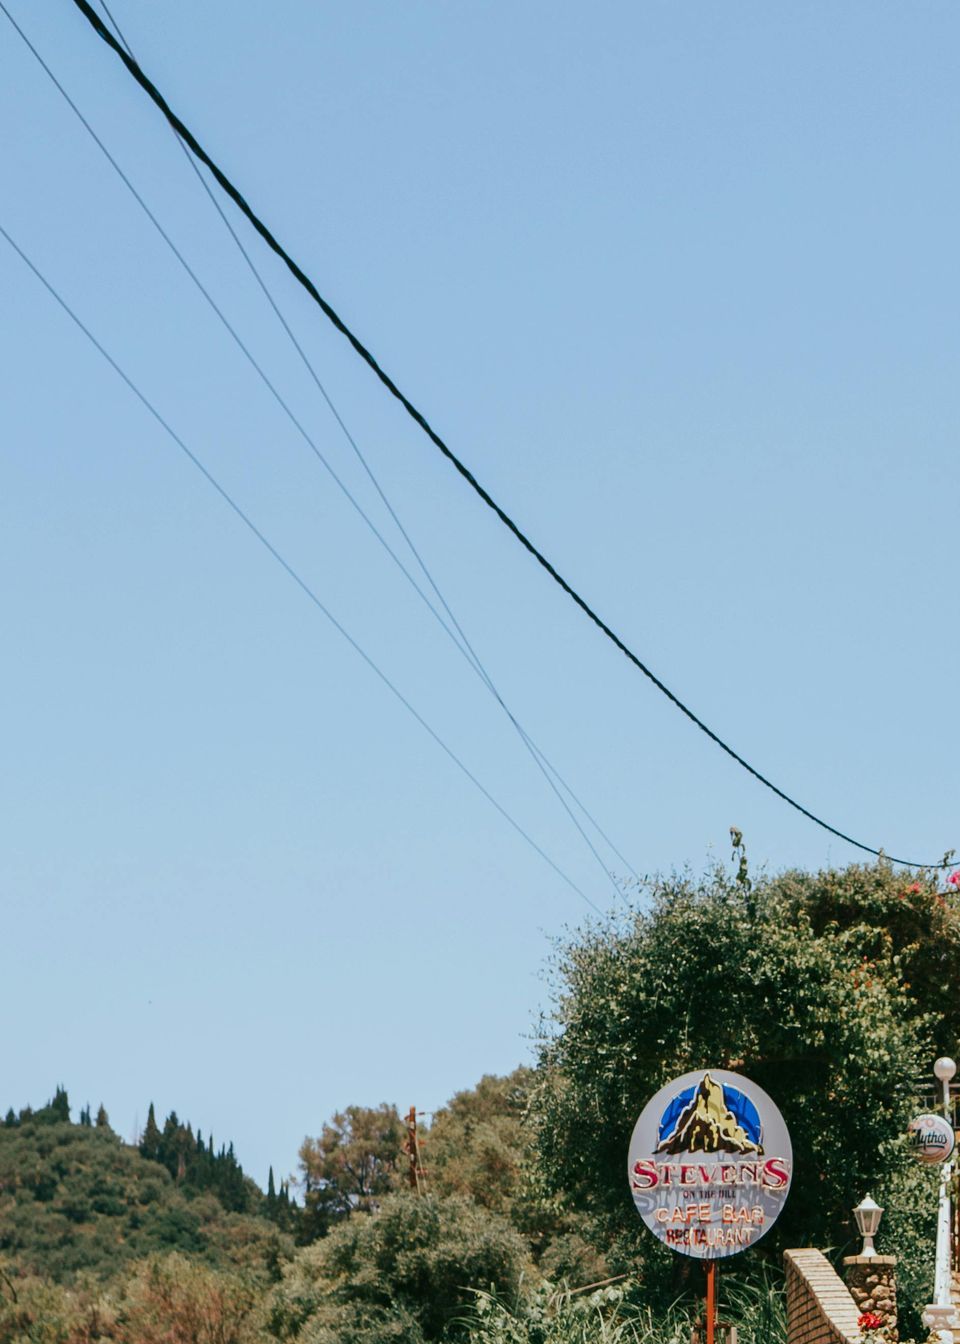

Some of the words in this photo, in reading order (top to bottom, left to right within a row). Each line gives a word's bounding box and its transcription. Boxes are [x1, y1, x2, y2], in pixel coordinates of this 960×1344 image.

[909, 1129, 947, 1150] Mythos
[683, 1190, 695, 1199] ON
[700, 1189, 716, 1199] THE
[719, 1189, 736, 1199] HILL
[655, 1203, 711, 1224] CAFE
[722, 1203, 765, 1224] BAR
[666, 1227, 756, 1246] RESTAURANT
